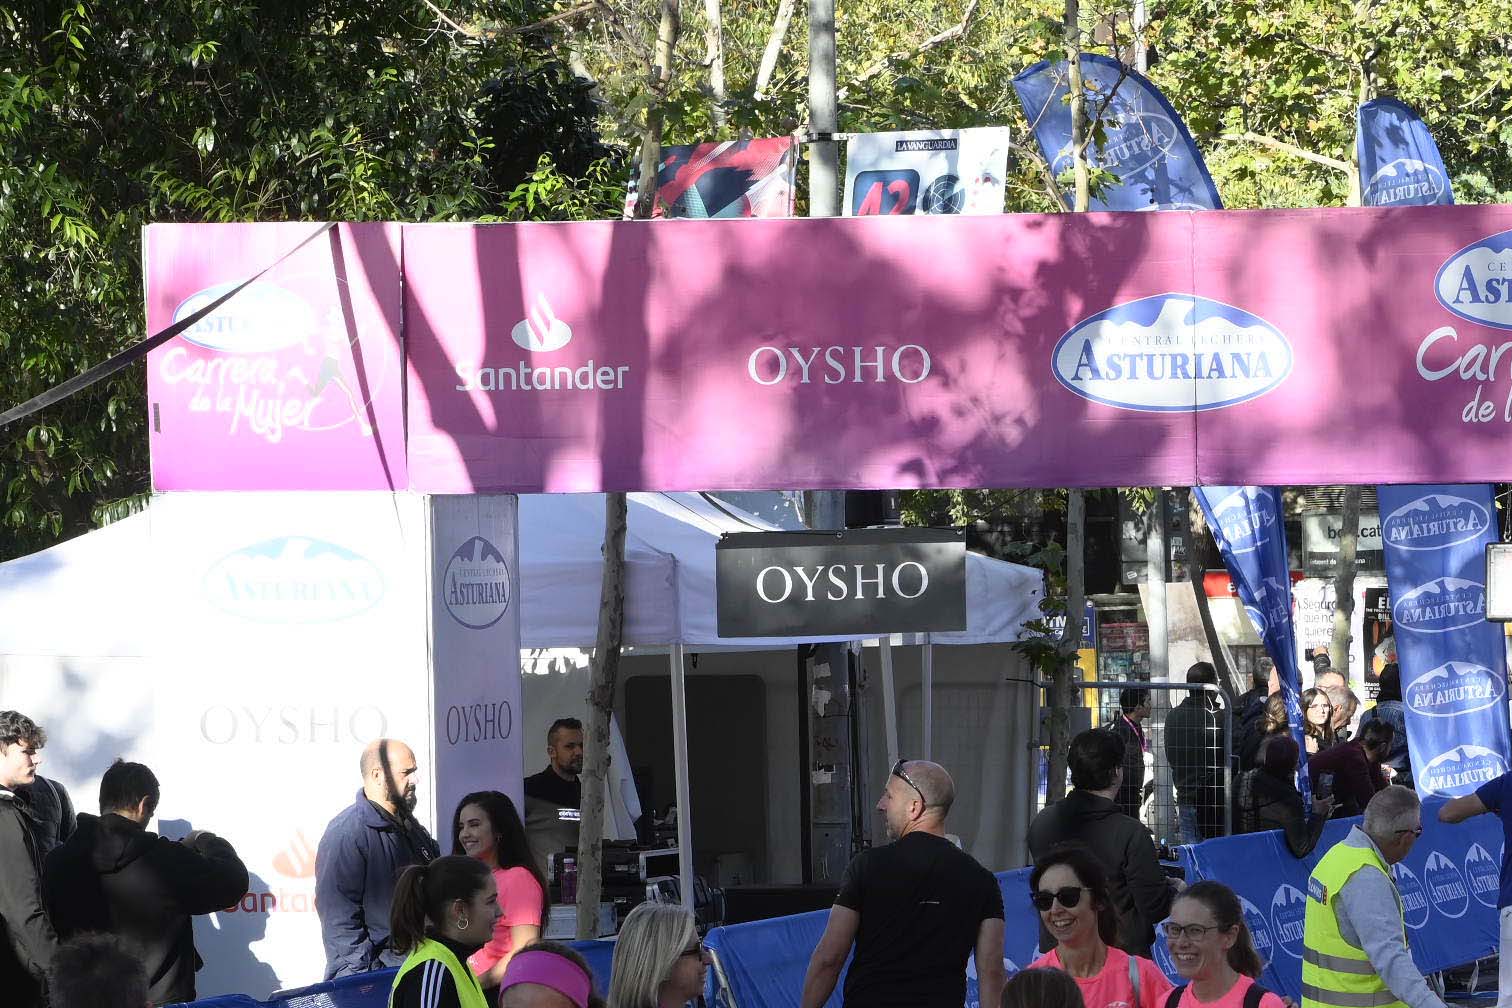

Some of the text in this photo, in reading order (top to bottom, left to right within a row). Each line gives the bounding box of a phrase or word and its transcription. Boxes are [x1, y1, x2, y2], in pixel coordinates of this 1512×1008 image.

[160, 346, 279, 385] Carrera
[455, 359, 629, 392] Santander
[747, 344, 932, 385] OYSHO
[1071, 338, 1273, 382] ASTURIANA
[1461, 388, 1496, 423] de
[449, 570, 507, 606] ASTURIANA
[755, 561, 930, 604] OYSHO
[200, 703, 388, 746] OYSHO
[446, 700, 512, 746] OYSHO
